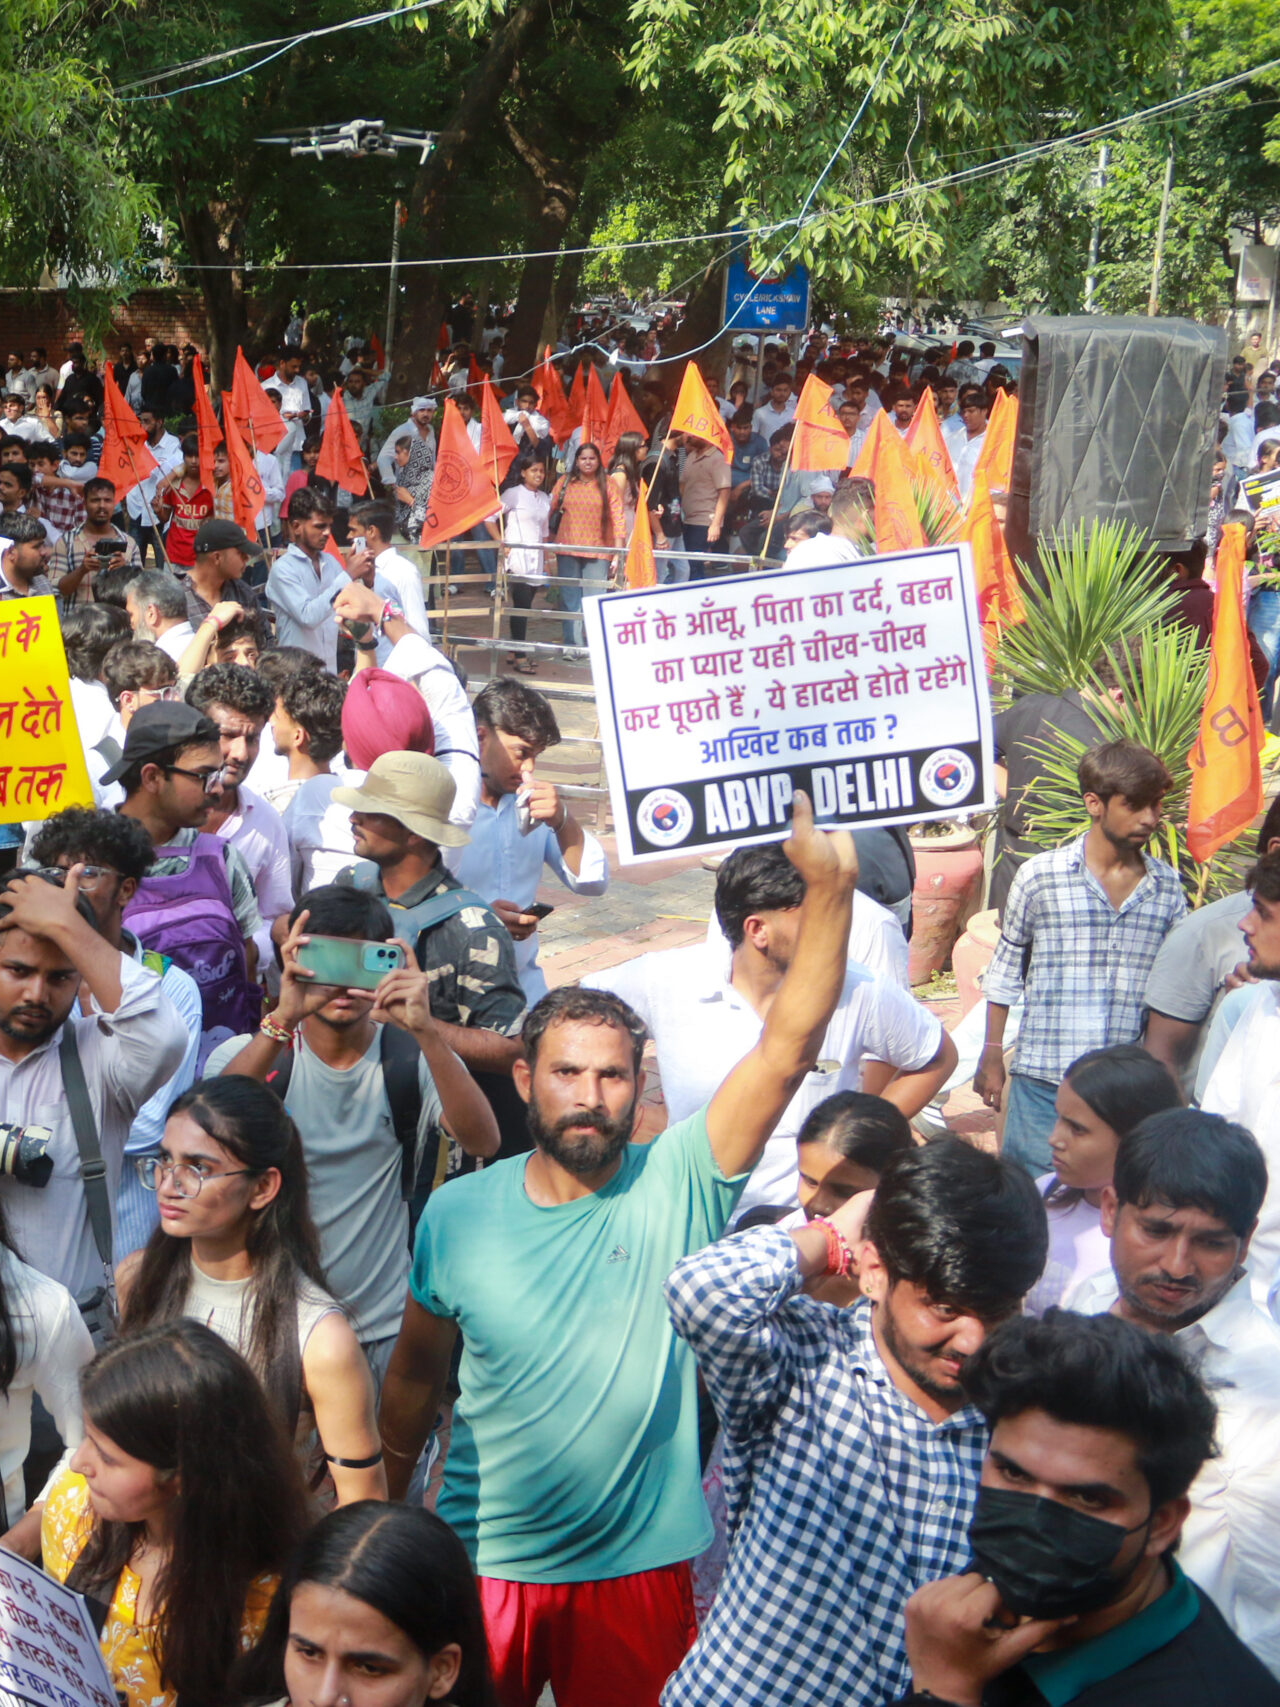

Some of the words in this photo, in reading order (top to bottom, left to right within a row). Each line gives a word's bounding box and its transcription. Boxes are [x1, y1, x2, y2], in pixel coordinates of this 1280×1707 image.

[756, 306, 776, 315] LANE
[16, 610, 42, 652] के
[614, 607, 646, 648] माँ
[653, 609, 676, 641] के
[686, 596, 746, 639] आँसू,
[752, 594, 804, 628] पिता
[813, 594, 843, 618] का
[849, 579, 891, 614] दर्द,
[898, 576, 954, 608] बहन
[652, 657, 684, 684] का
[691, 648, 743, 679] प्यार
[749, 637, 795, 670] यही
[801, 620, 927, 663] चीख-चीख
[21, 685, 64, 739] देते
[621, 704, 660, 733] कर
[667, 689, 720, 734] पूछते
[766, 679, 786, 711] ये
[792, 670, 858, 706] हादसे
[865, 662, 909, 699] होते
[916, 654, 967, 692] रहेंगे
[699, 726, 780, 765] आखिर
[788, 723, 827, 752] कब
[836, 714, 876, 744] तक
[15, 762, 67, 806] तक
[703, 772, 793, 836] ABVP
[811, 756, 915, 819] DELHI
